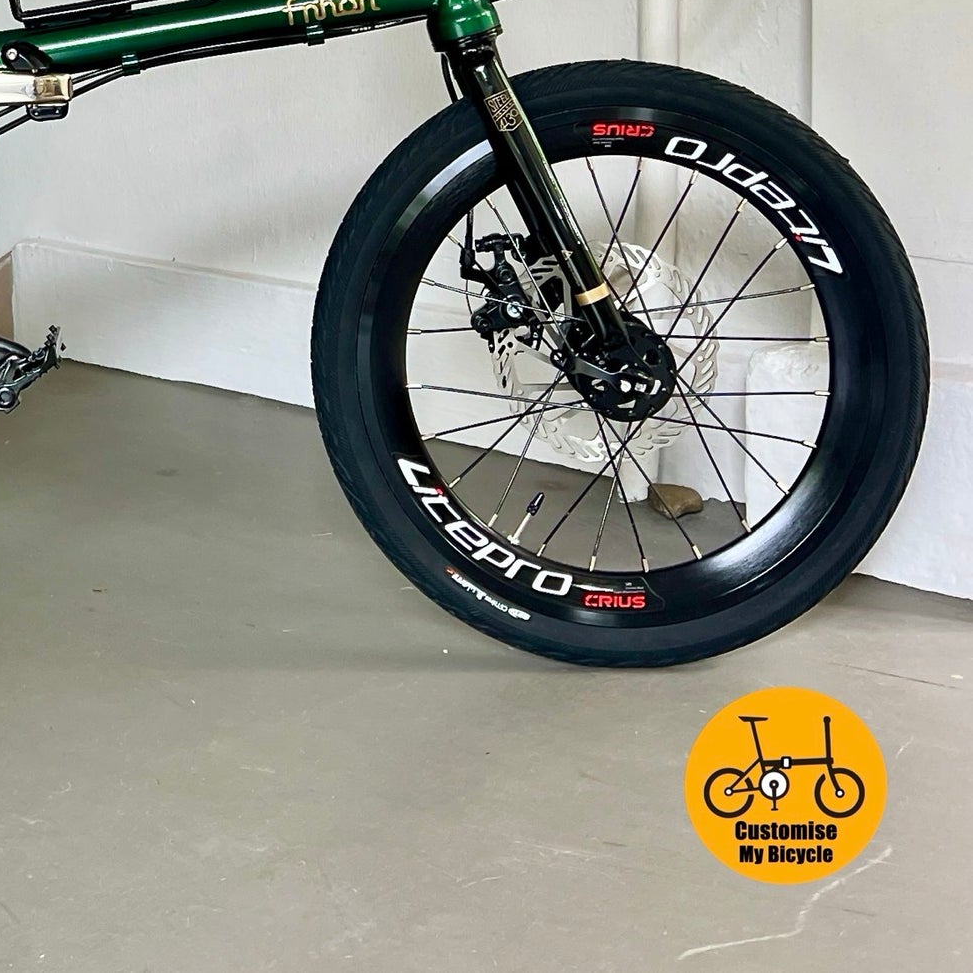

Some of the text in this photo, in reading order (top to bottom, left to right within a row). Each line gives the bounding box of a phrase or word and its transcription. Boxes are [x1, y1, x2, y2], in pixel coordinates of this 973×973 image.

[487, 93, 510, 113] STEEL
[592, 123, 655, 138] CRIUS
[584, 593, 646, 610] CRIUS
